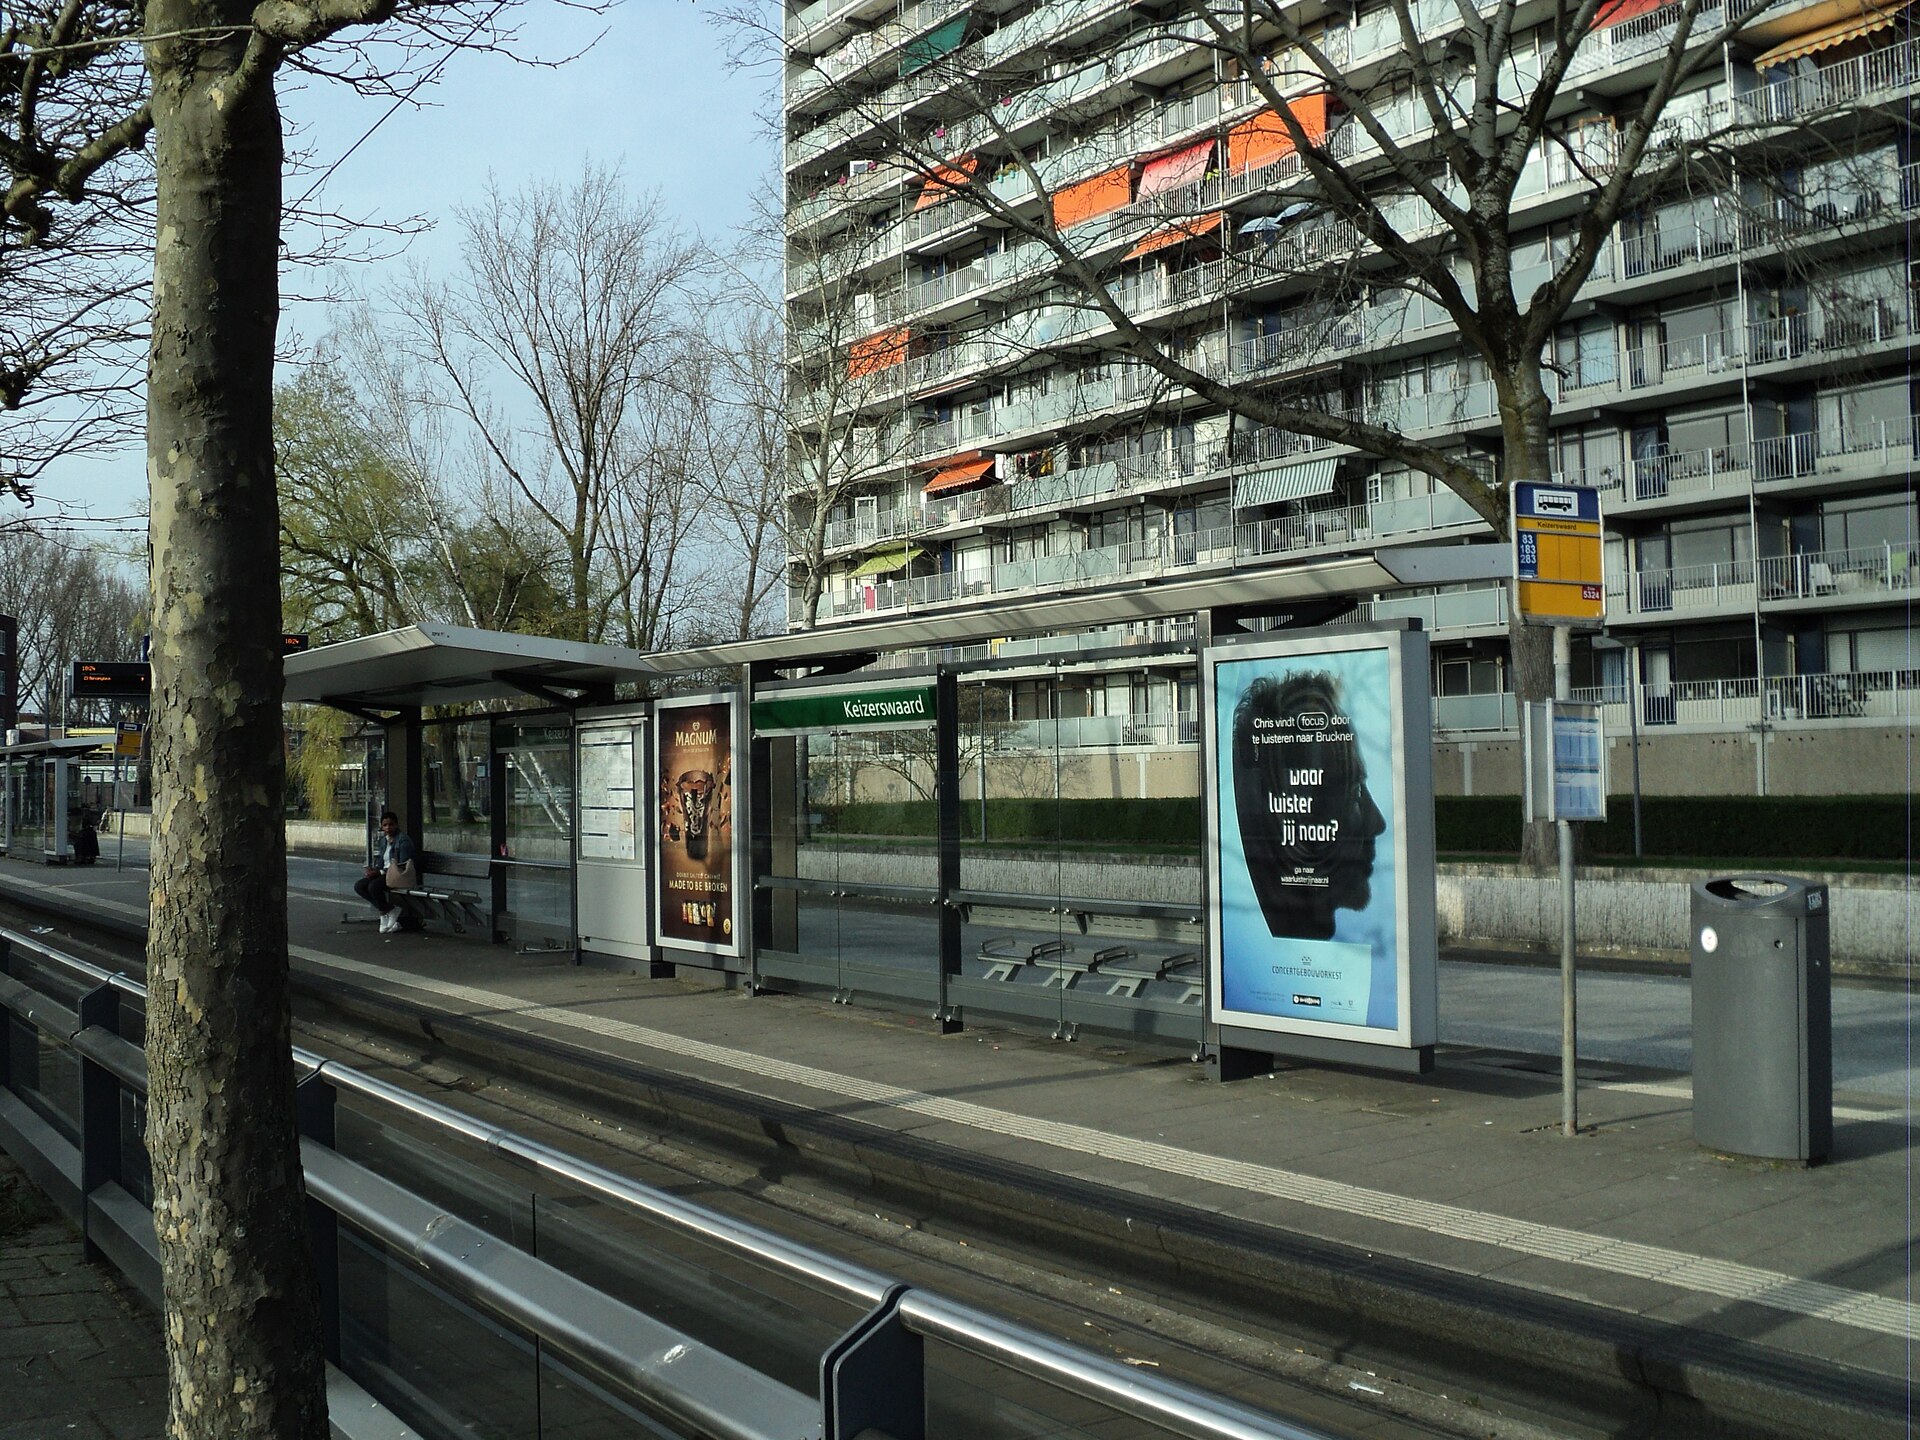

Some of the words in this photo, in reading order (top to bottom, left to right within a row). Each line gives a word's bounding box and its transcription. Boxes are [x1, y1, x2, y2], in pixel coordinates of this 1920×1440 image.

[1537, 521, 1577, 530] Keizerswaard
[1522, 534, 1533, 544] 83
[1520, 545, 1536, 554] 183
[1520, 555, 1536, 564] 283
[1583, 591, 1600, 599] 5324
[843, 694, 925, 718] Keizerswaard
[1254, 717, 1274, 729] Chris
[1275, 716, 1295, 728] vindt
[1301, 715, 1325, 726] focus
[1331, 714, 1351, 725] door
[675, 728, 718, 747] MAGNUM
[1252, 735, 1260, 745] te
[1261, 733, 1295, 744] luisteren
[1296, 734, 1314, 743] naar
[1316, 731, 1354, 742] Bruckner
[1289, 769, 1324, 785] waar
[1269, 792, 1313, 813] luister
[1281, 819, 1296, 846] jij
[1299, 819, 1339, 841] naar?
[669, 880, 686, 889] MADE
[687, 880, 694, 890] TO
[695, 881, 703, 891] BE
[705, 881, 728, 893] BROKEN
[1272, 966, 1342, 979] CONCERTGEBOUWORKEST
